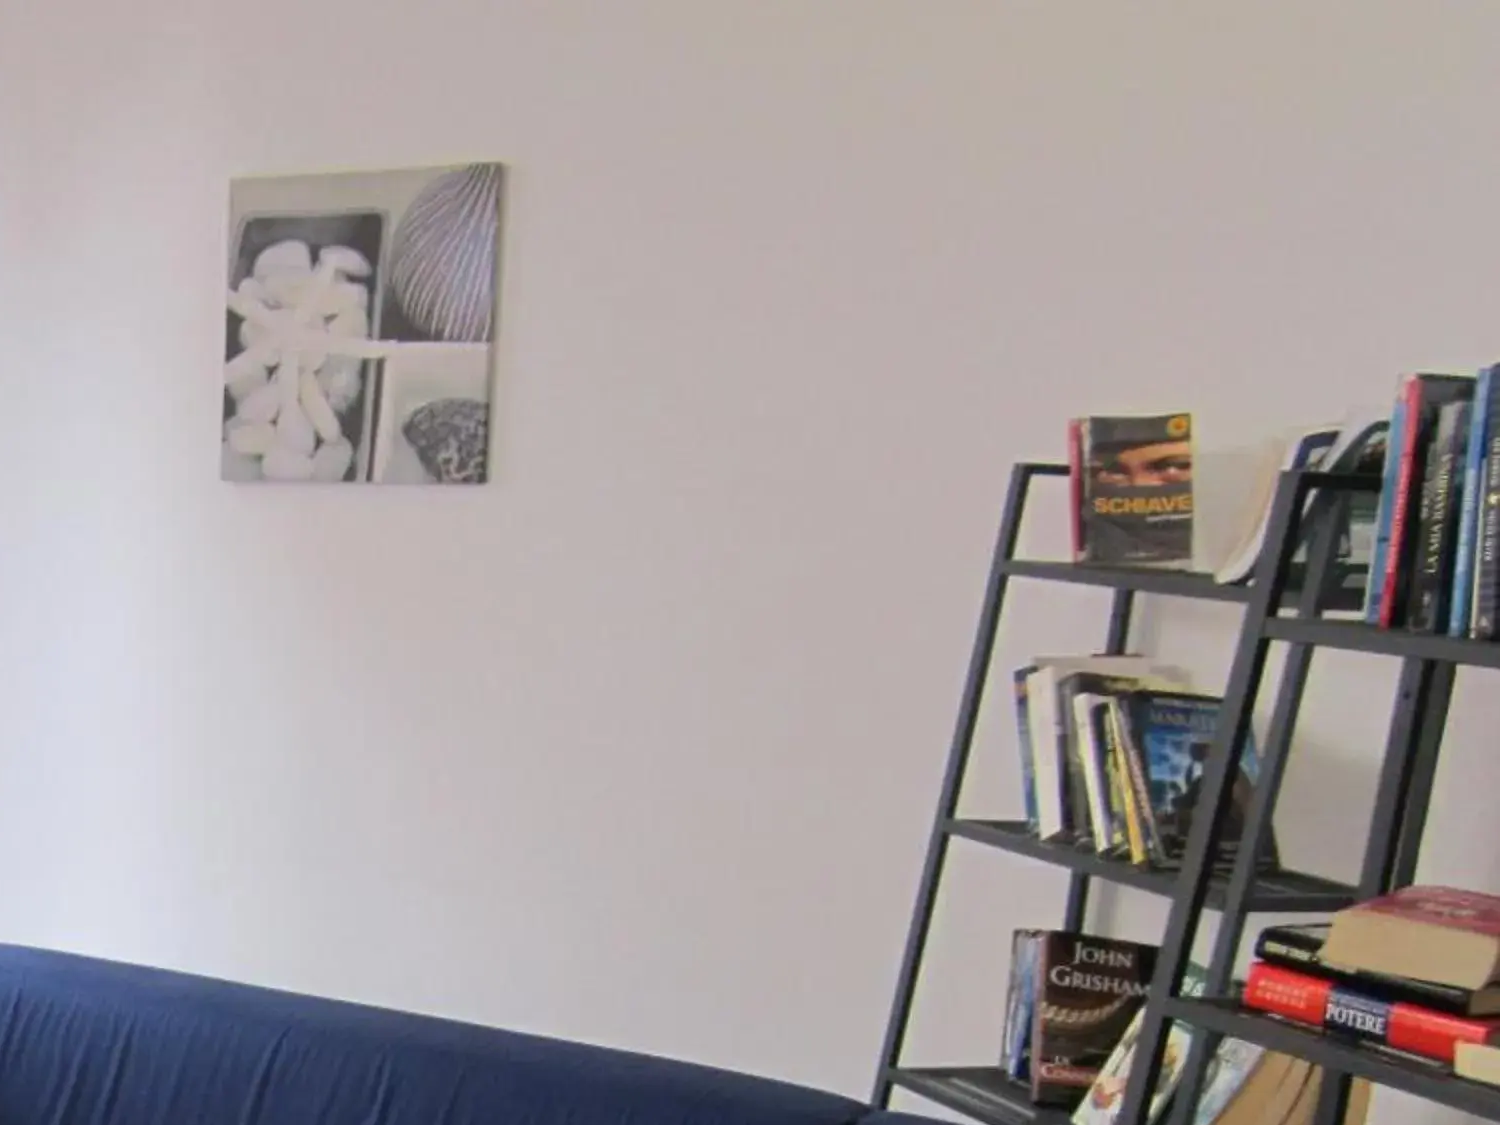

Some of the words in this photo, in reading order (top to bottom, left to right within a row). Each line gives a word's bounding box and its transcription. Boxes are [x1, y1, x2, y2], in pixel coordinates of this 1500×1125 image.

[1094, 494, 1192, 514] SCHIAVE
[1073, 941, 1133, 968] JOHN
[1325, 1003, 1387, 1035] POTERE
